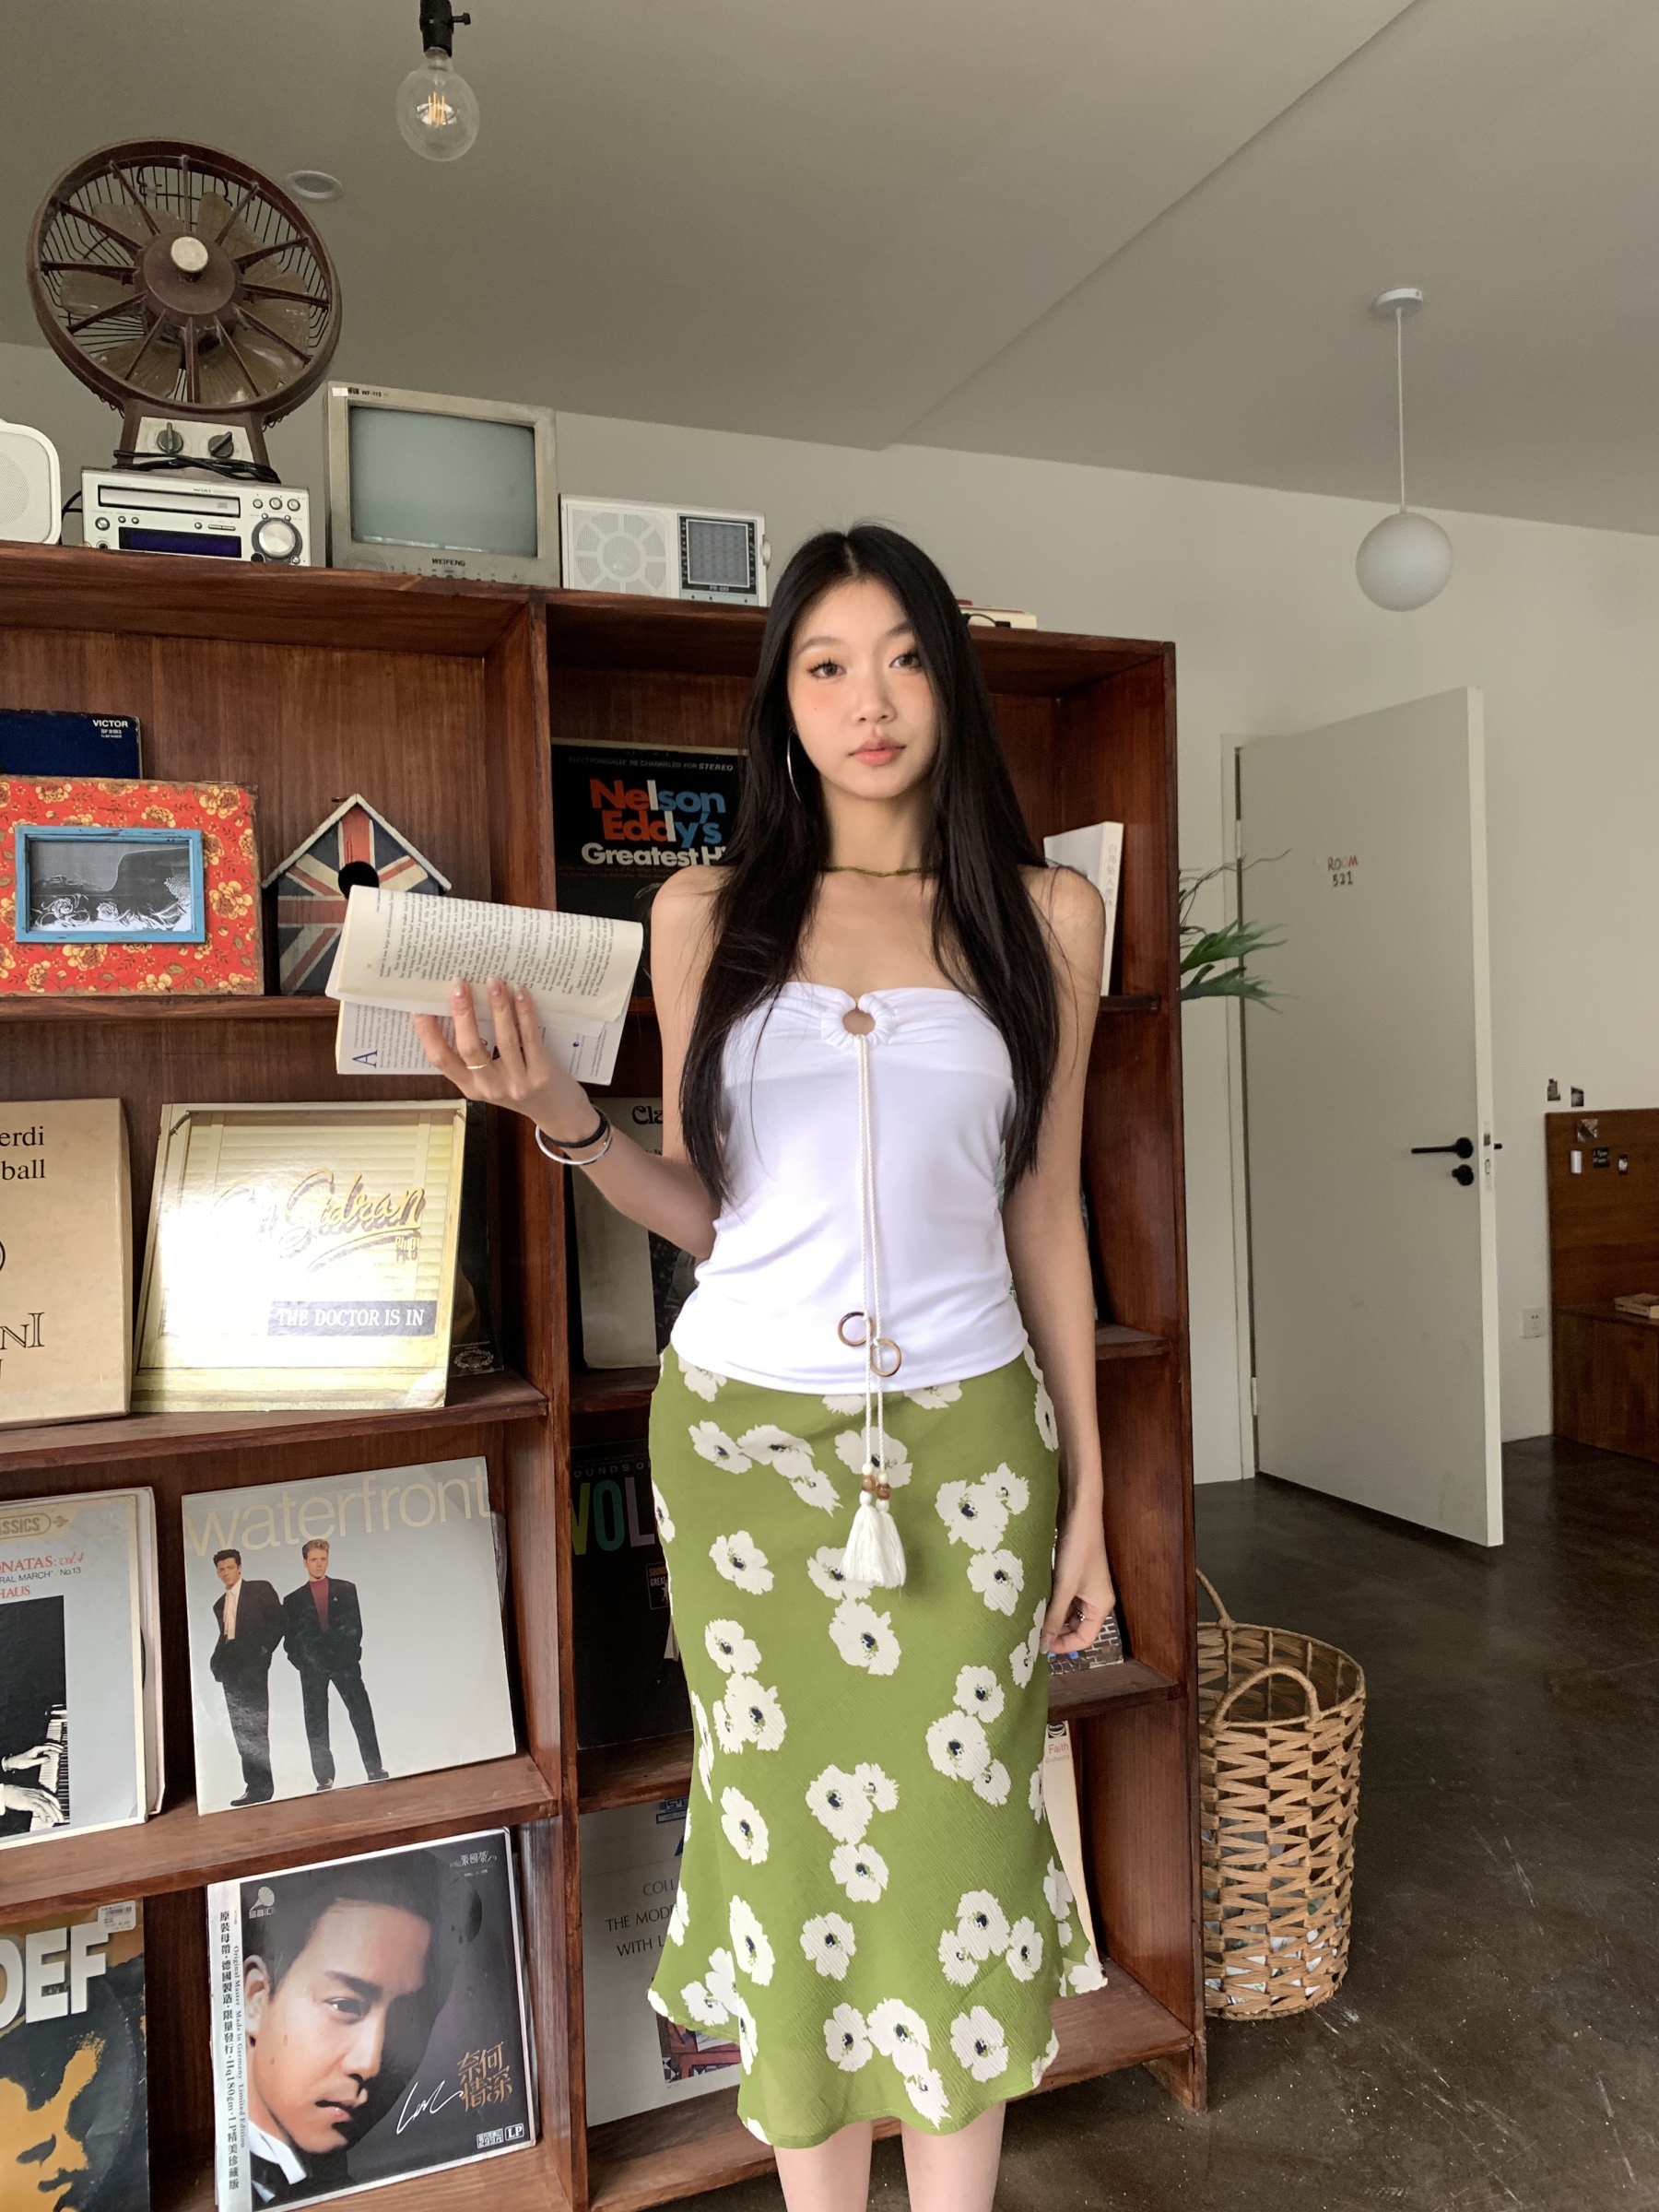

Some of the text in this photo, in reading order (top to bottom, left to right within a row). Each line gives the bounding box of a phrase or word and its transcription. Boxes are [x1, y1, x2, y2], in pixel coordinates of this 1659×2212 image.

[431, 558, 465, 567] WEIFENG
[93, 719, 128, 727] VICTOR
[698, 763, 734, 771] STEREO
[589, 778, 726, 814] Nelson
[602, 809, 723, 849] Eddy's
[581, 842, 698, 867] Greatest
[1328, 855, 1358, 871] ROOM
[1333, 871, 1352, 886] 521
[0, 1125, 44, 1147] erdi
[277, 1309, 424, 1326] THE DOCTOR IS IN
[184, 1465, 490, 1557] waterfront
[1049, 1742, 1069, 1754] Faith
[606, 1915, 631, 1932] THE
[617, 1937, 653, 1957] WITH
[232, 1946, 241, 1978] Original
[237, 2033, 242, 2041] in
[508, 2125, 523, 2138] LP
